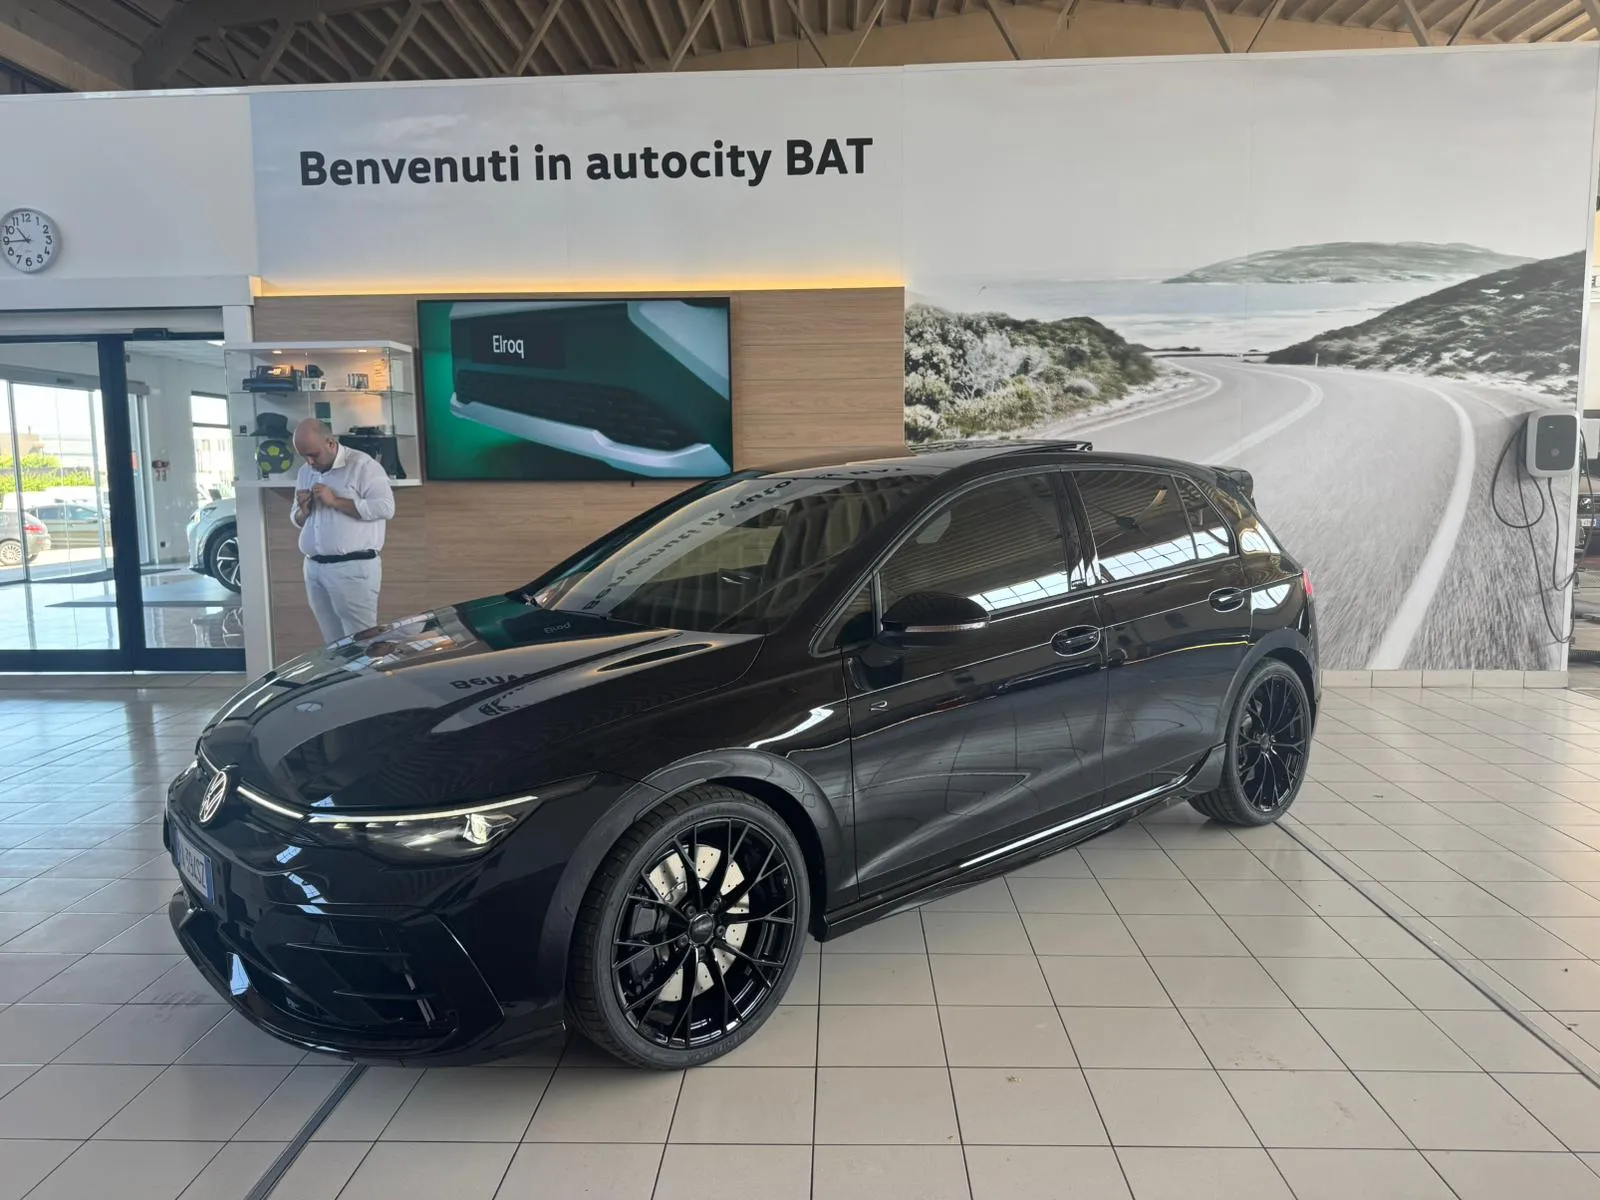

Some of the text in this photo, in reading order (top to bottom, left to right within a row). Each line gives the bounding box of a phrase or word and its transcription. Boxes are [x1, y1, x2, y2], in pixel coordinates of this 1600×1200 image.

[300, 137, 873, 187] Benvenuti in autocity BAT
[12, 216, 19, 226] 11
[21, 213, 31, 223] 12
[35, 216, 40, 226] 1
[5, 225, 15, 235] 10
[43, 224, 49, 234] 2
[3, 236, 10, 245] 9
[45, 235, 52, 245] 3
[8, 246, 14, 256] 8
[44, 246, 50, 255] 4
[16, 254, 22, 264] 7
[26, 257, 33, 267] 6
[37, 254, 43, 264] 5
[492, 334, 525, 359] Elroq
